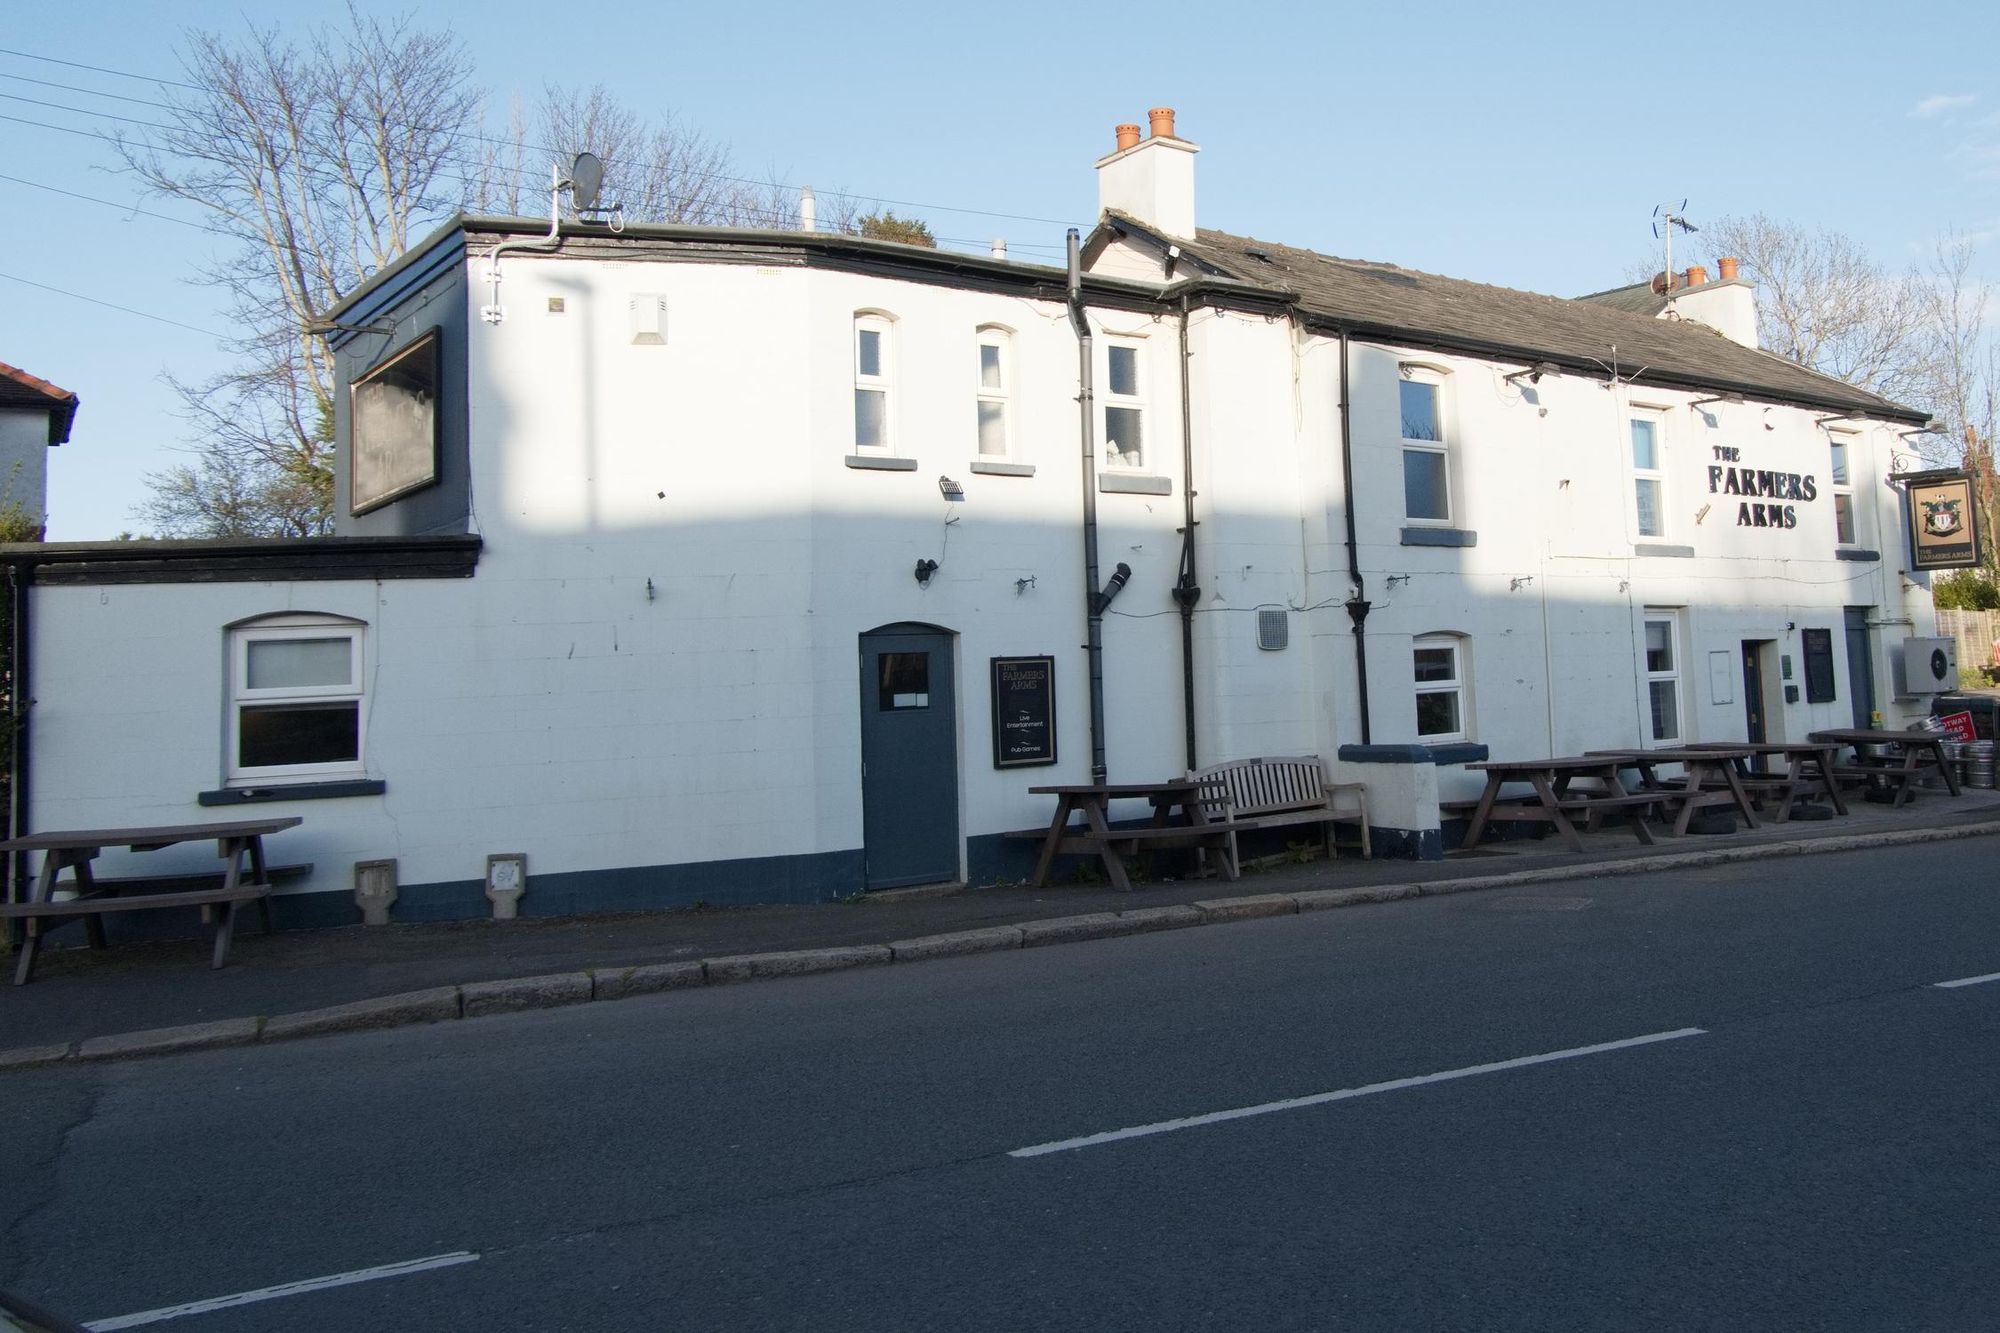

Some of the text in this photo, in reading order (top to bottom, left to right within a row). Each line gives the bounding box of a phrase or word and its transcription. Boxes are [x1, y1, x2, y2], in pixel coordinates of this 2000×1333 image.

[1712, 445, 1741, 462] THE
[1707, 465, 1817, 502] FARMERS
[1736, 502, 1797, 530] ARMS
[1920, 550, 1971, 561] FARMERS ARMS
[1002, 671, 1045, 681] FARMERS
[1010, 680, 1038, 690] ARMS
[1007, 721, 1044, 729] Entertainment
